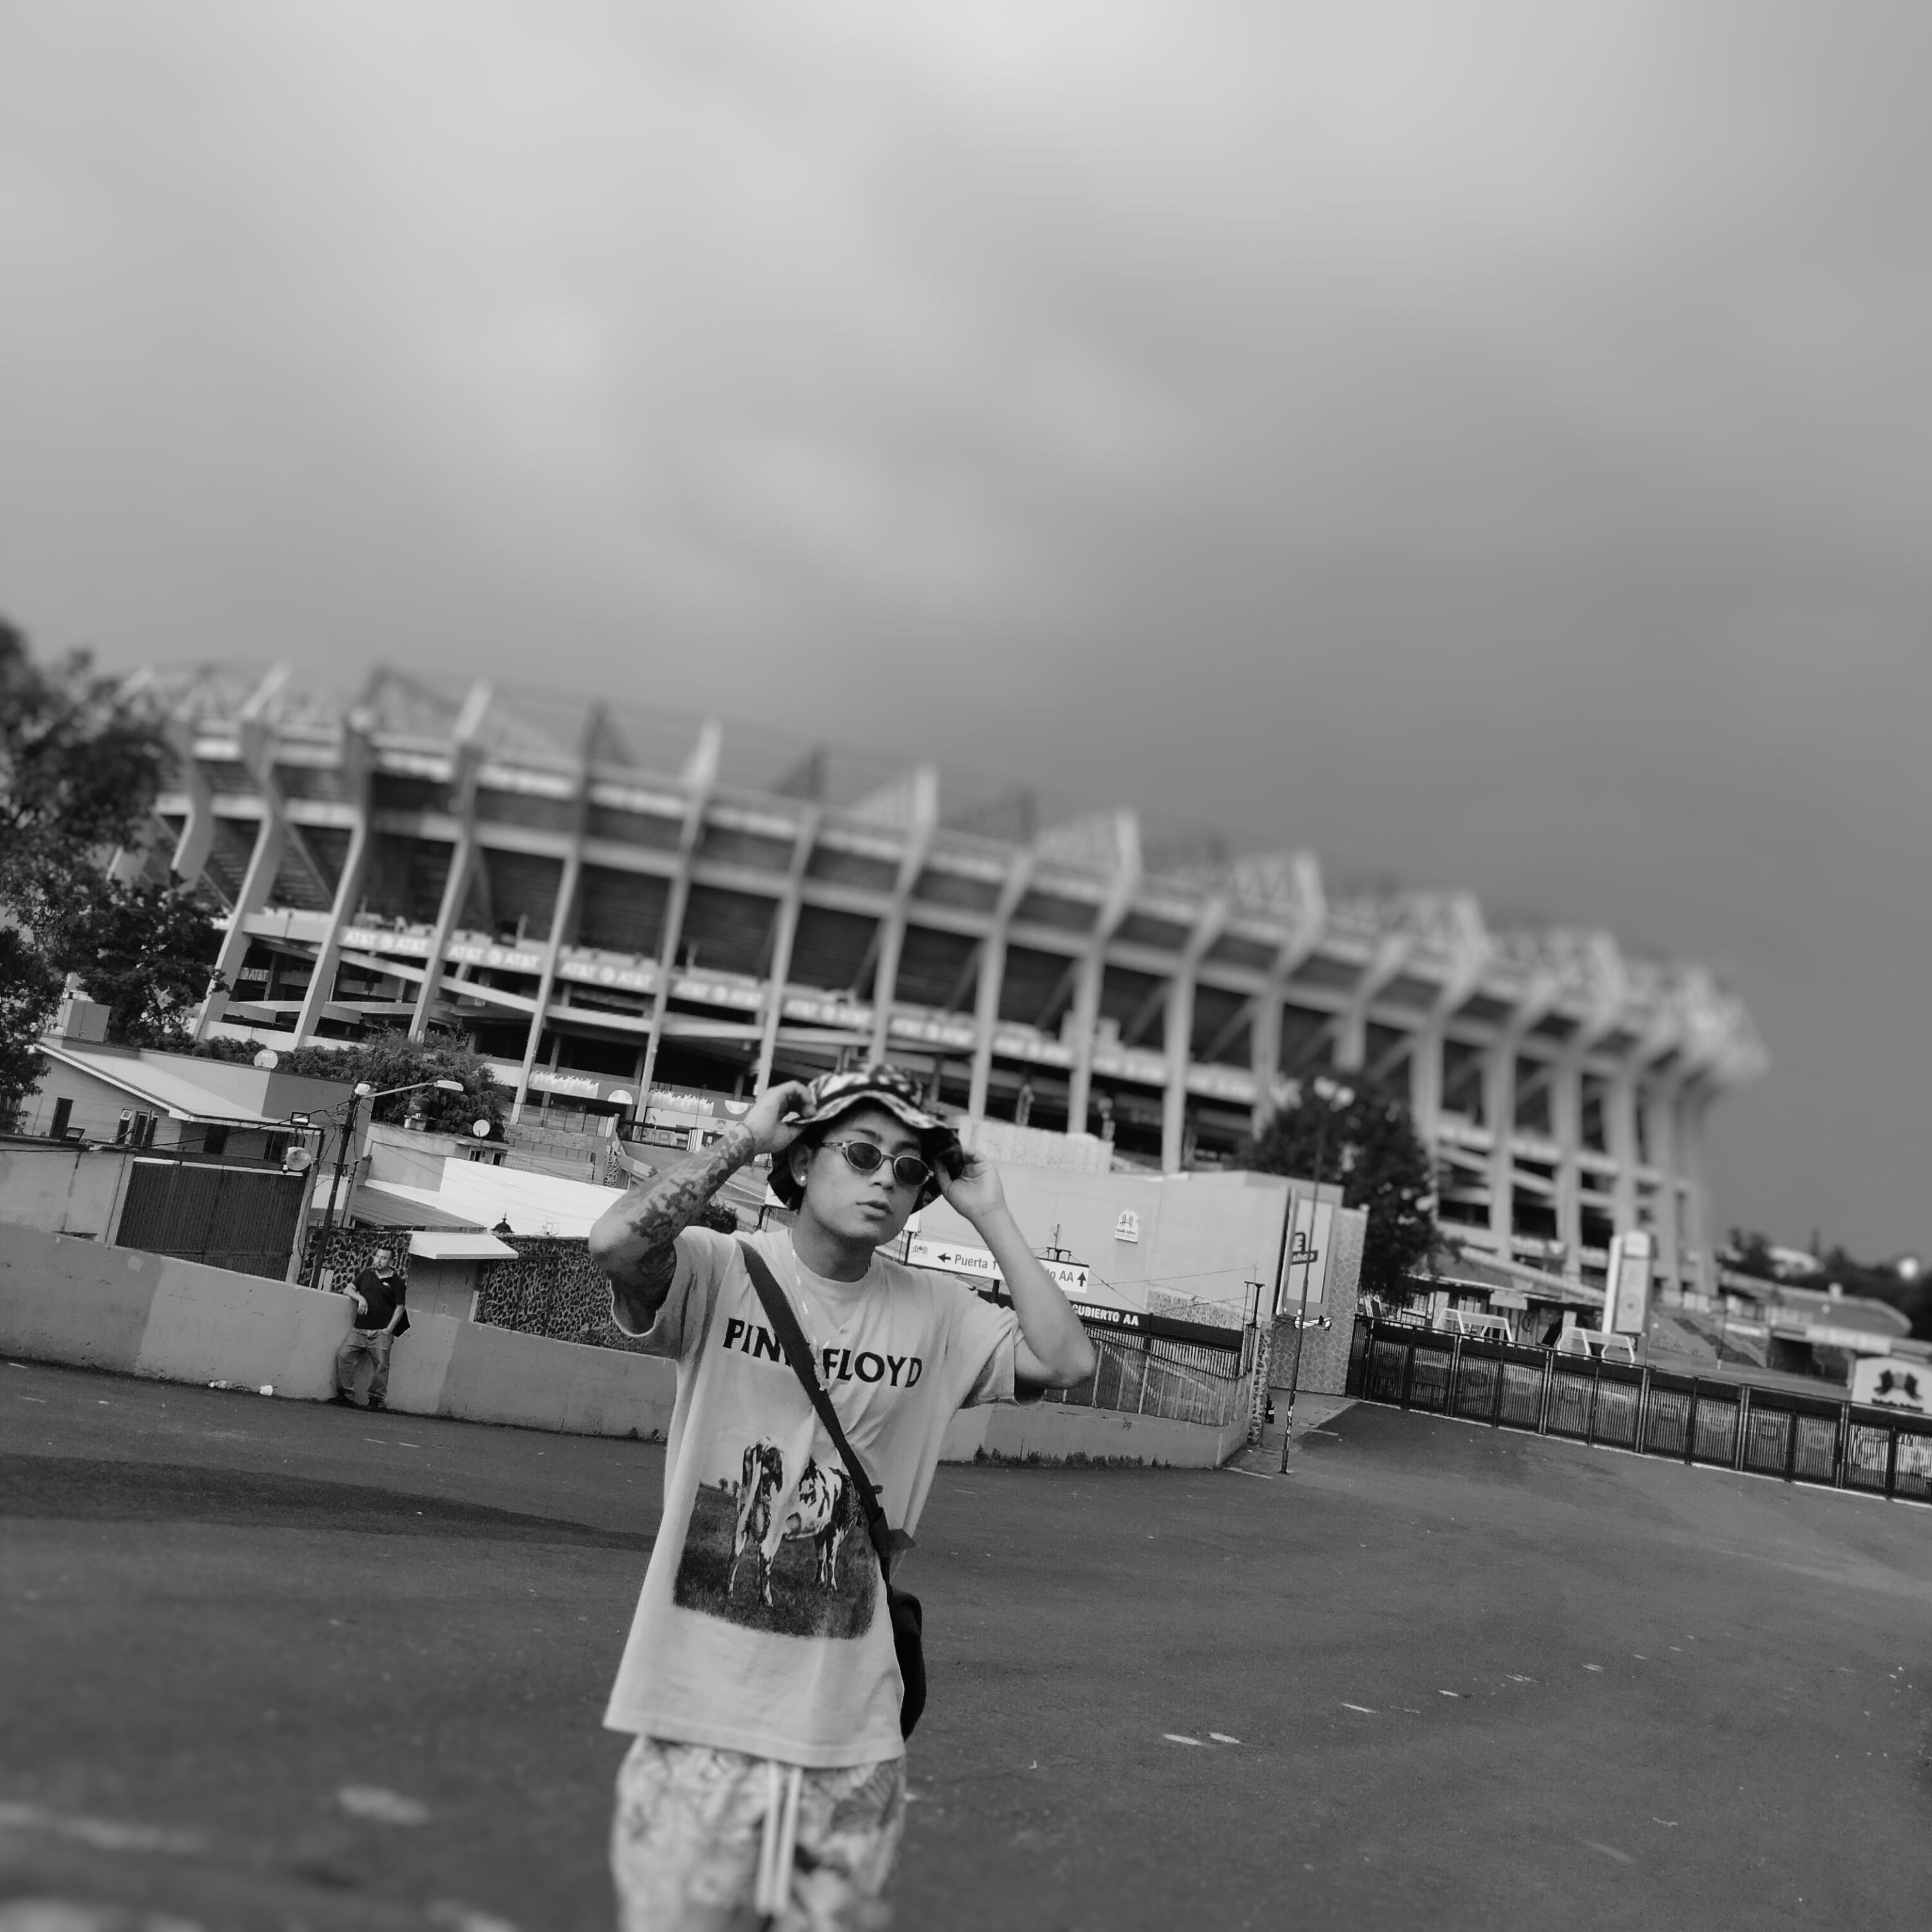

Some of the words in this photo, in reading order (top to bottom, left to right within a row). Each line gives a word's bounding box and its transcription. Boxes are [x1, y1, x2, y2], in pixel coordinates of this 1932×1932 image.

[344, 931, 375, 946] AT&T
[448, 945, 483, 960] AT&T
[503, 952, 540, 969] AT&T
[248, 969, 269, 981] AT&T
[954, 1254, 988, 1269] Puerta
[1059, 1270, 1074, 1283] AA
[1072, 1303, 1121, 1322] CUBIERTO
[1122, 1314, 1139, 1326] AA
[723, 1318, 791, 1367] PIN
[822, 1348, 923, 1388] FLOYD
